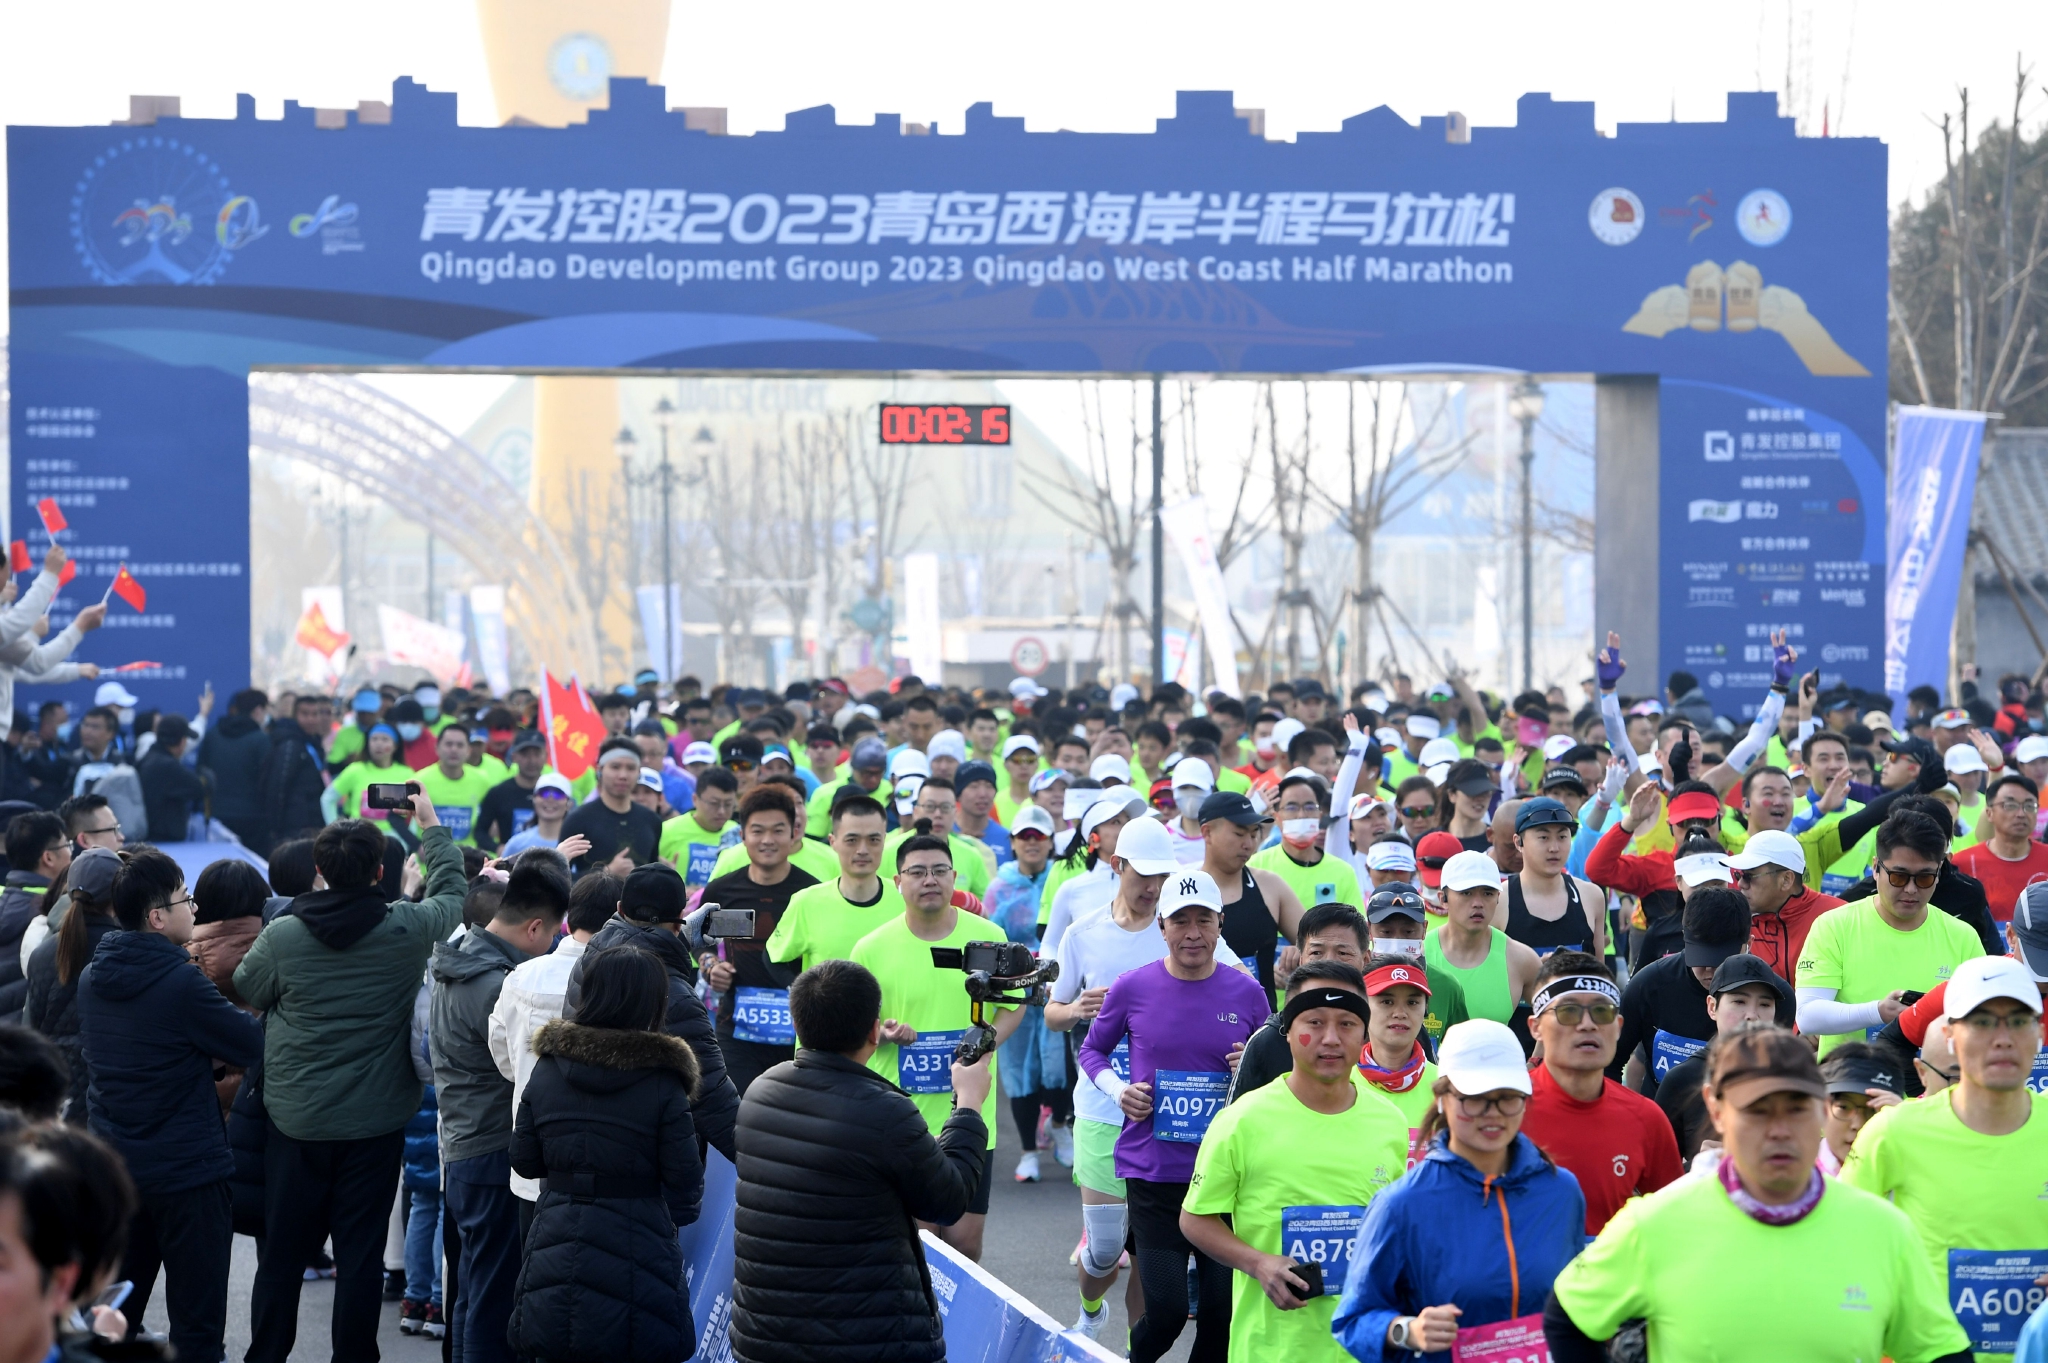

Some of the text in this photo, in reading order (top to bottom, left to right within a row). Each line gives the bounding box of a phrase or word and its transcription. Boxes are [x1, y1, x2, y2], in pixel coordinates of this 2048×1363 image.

[420, 187, 1516, 246] 青发控股2023青岛西海岸半程马拉松
[420, 252, 1513, 287] Qingdao Development Group 2023 Qingdao West Coast Half Marathon
[1740, 431, 1842, 450] 青发控股集团
[1015, 976, 1039, 987] RONIN
[735, 1007, 792, 1026] A5533
[1955, 1286, 2045, 1316] A608
